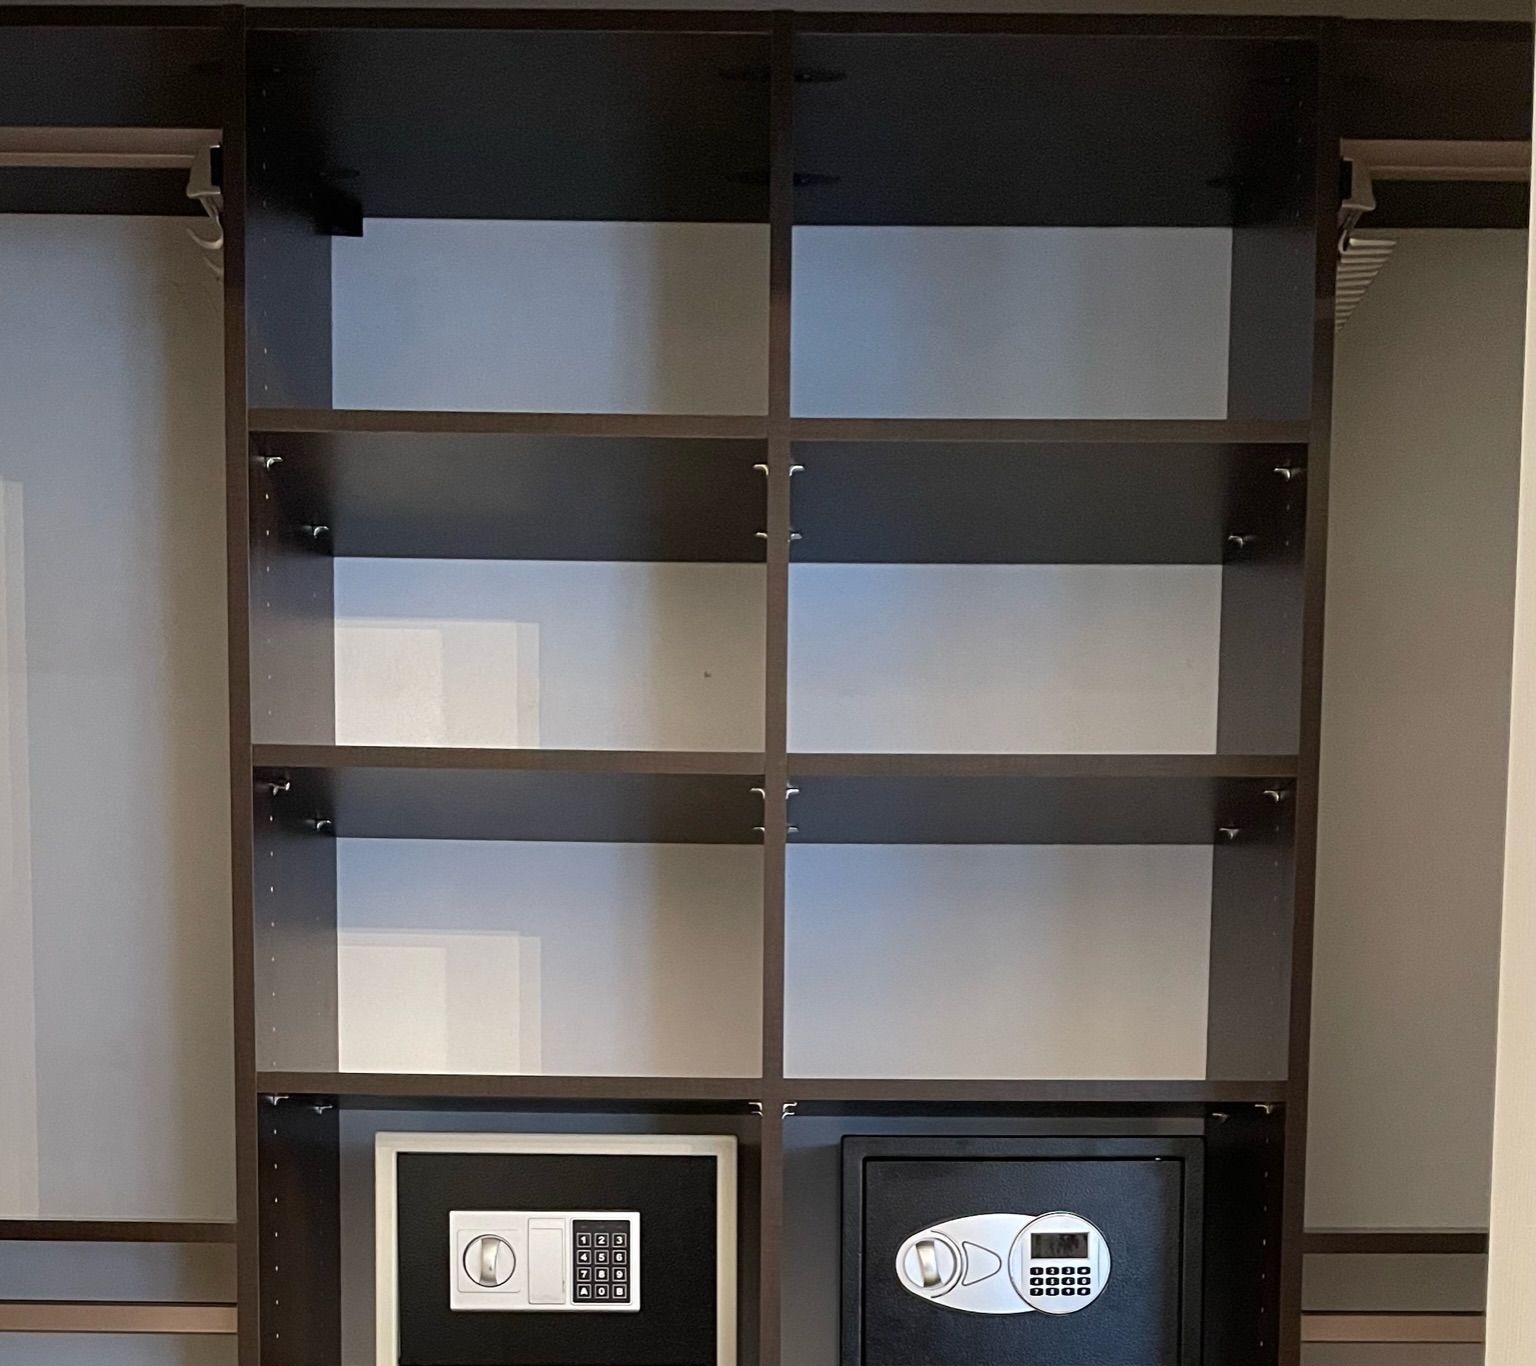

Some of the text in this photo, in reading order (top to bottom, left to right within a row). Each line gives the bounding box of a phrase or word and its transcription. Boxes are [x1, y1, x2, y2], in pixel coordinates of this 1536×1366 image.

[580, 1236, 623, 1244] 1 2 3
[580, 1253, 623, 1261] 4 5 6
[580, 1270, 623, 1278] 7 8 9
[580, 1287, 623, 1295] A 0 B
